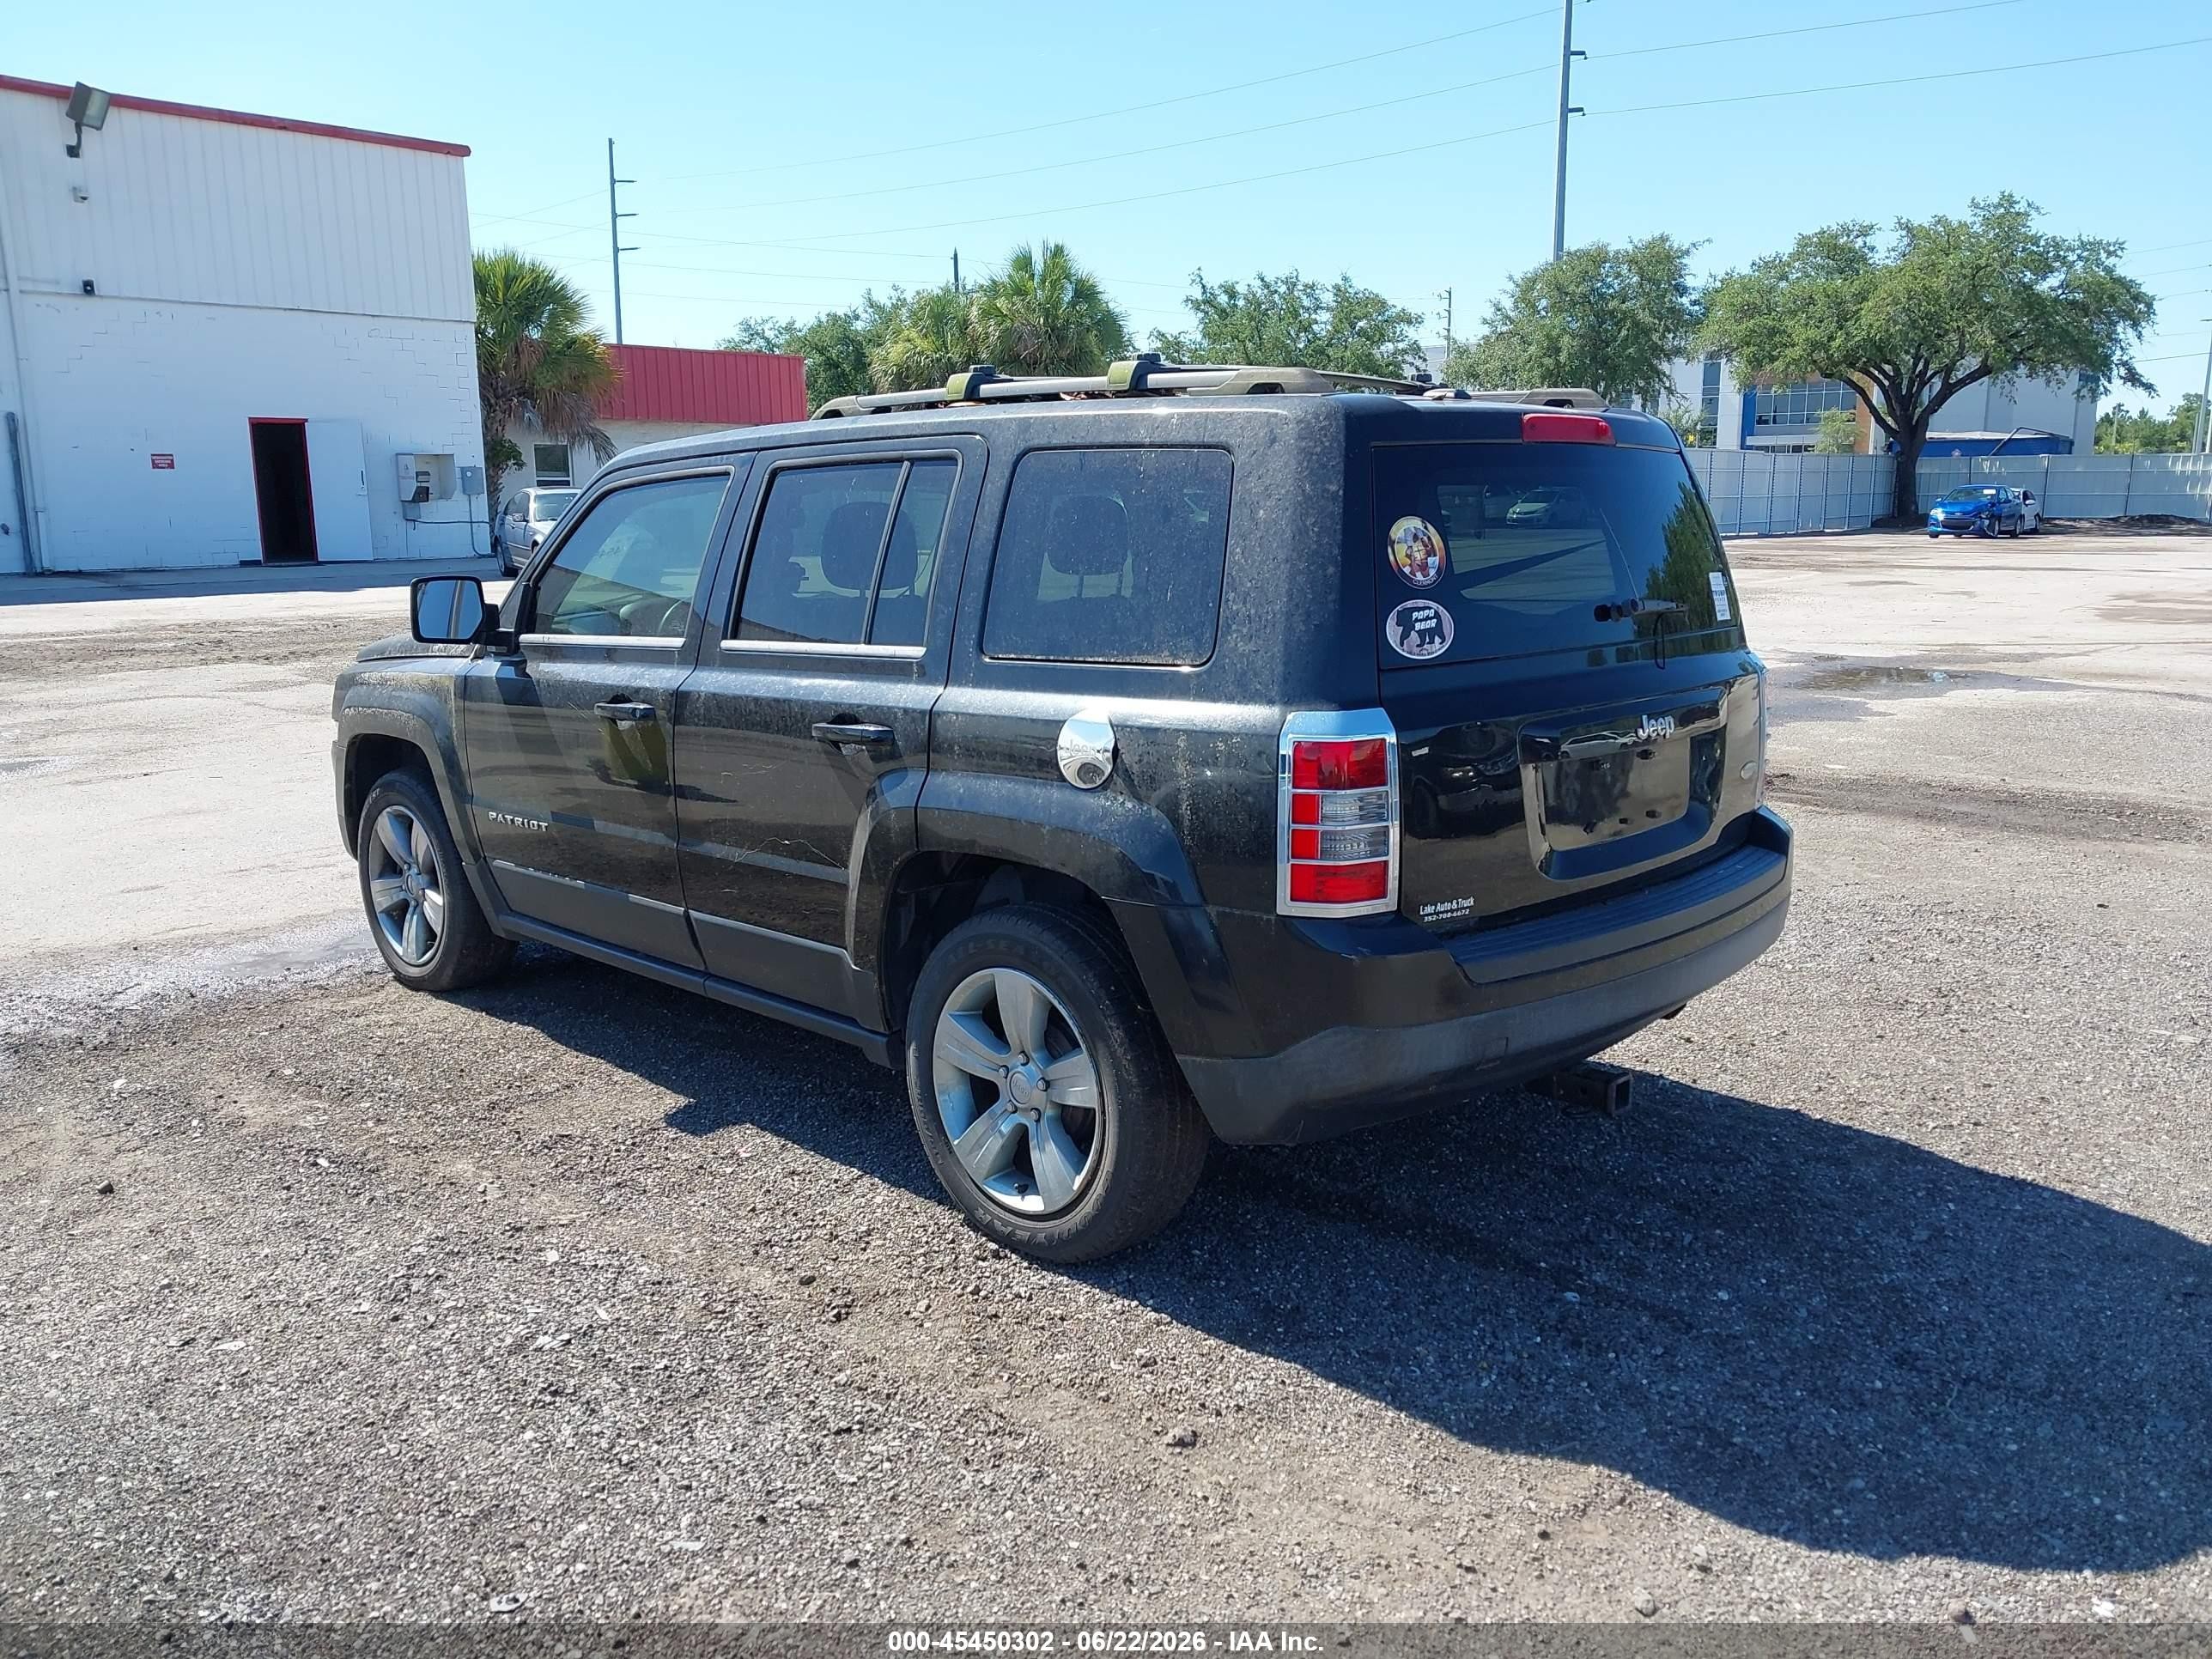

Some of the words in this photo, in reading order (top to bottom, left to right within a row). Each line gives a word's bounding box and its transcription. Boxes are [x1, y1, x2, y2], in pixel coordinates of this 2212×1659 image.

[1412, 608, 1435, 621] PAPA
[1414, 618, 1437, 631] BEAR
[1636, 714, 1674, 739] Jeep
[488, 811, 549, 832] PATRIOT
[1419, 904, 1435, 915] Lake
[974, 1170, 1113, 1247] GOODYEAR
